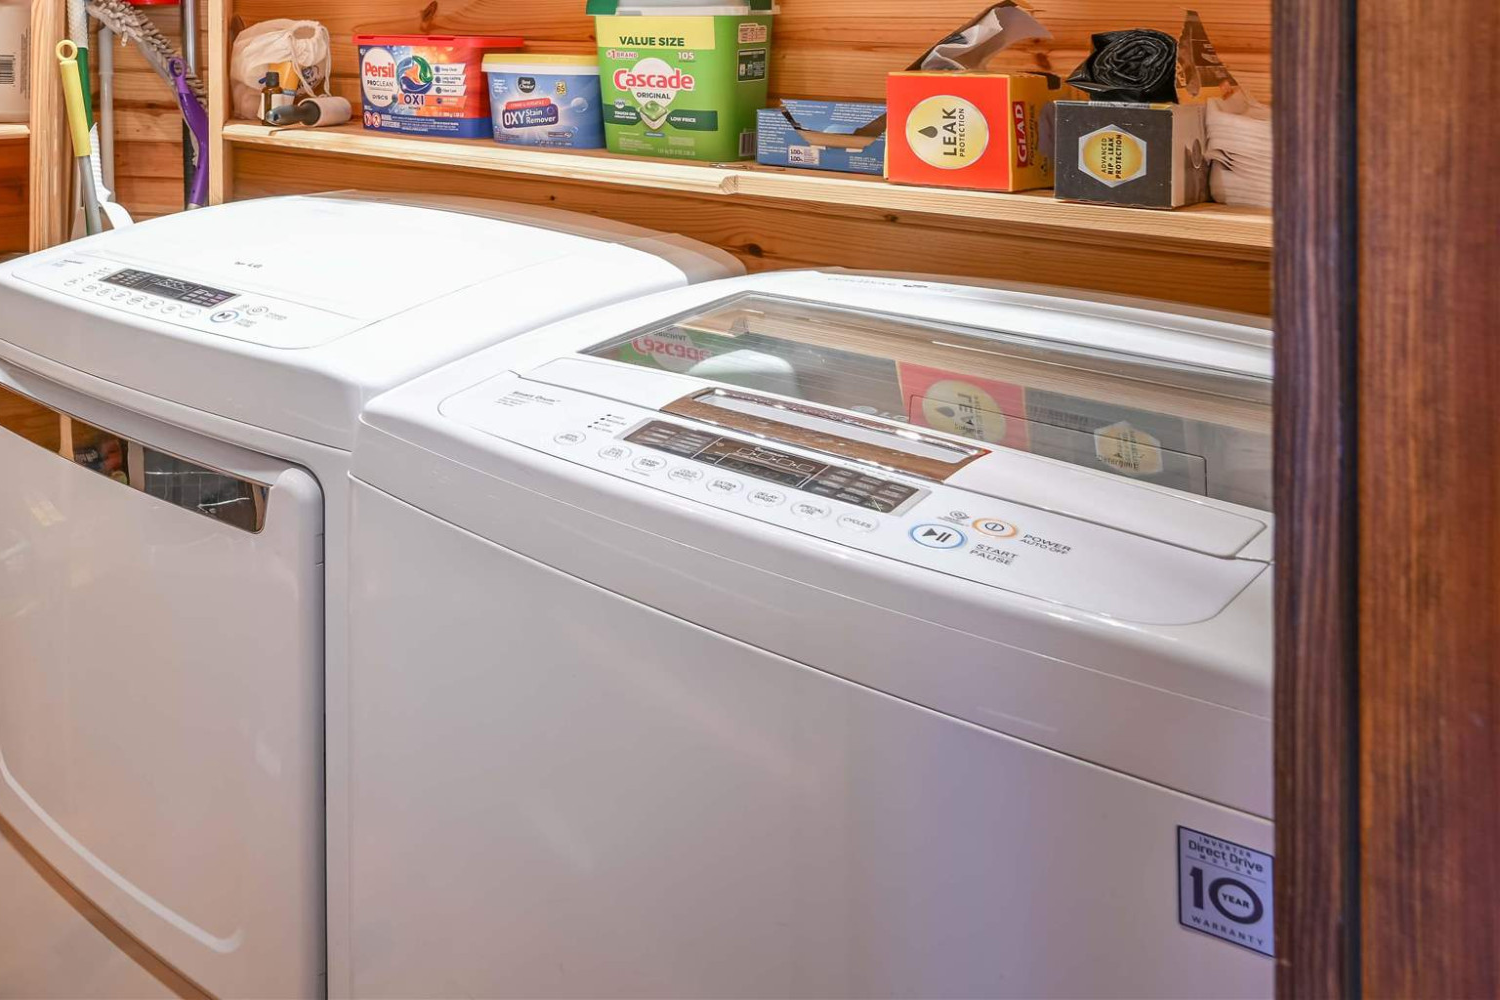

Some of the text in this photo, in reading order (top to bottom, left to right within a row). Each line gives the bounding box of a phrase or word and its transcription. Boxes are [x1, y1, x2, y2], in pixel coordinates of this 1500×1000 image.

[619, 36, 685, 46] VALUE SIZE
[365, 62, 394, 78] Persil
[614, 69, 694, 90] Cascade
[404, 95, 424, 105] OXI
[504, 111, 525, 125] OXY
[526, 109, 542, 117] Stain
[526, 116, 556, 124] Remover
[942, 108, 958, 157] LEAK
[1015, 104, 1027, 162] GLAD
[843, 516, 872, 529] CYCLES
[1019, 538, 1068, 555] AUTO OFF
[1023, 533, 1072, 552] POWER
[970, 549, 1014, 565] PAUSE
[976, 543, 1019, 559] START
[1188, 839, 1264, 873] Direct Drive
[1199, 837, 1252, 859] INVERTER
[1189, 866, 1264, 925] 10
[1222, 893, 1250, 909] YEAR
[1192, 914, 1264, 947] WARRANTY
